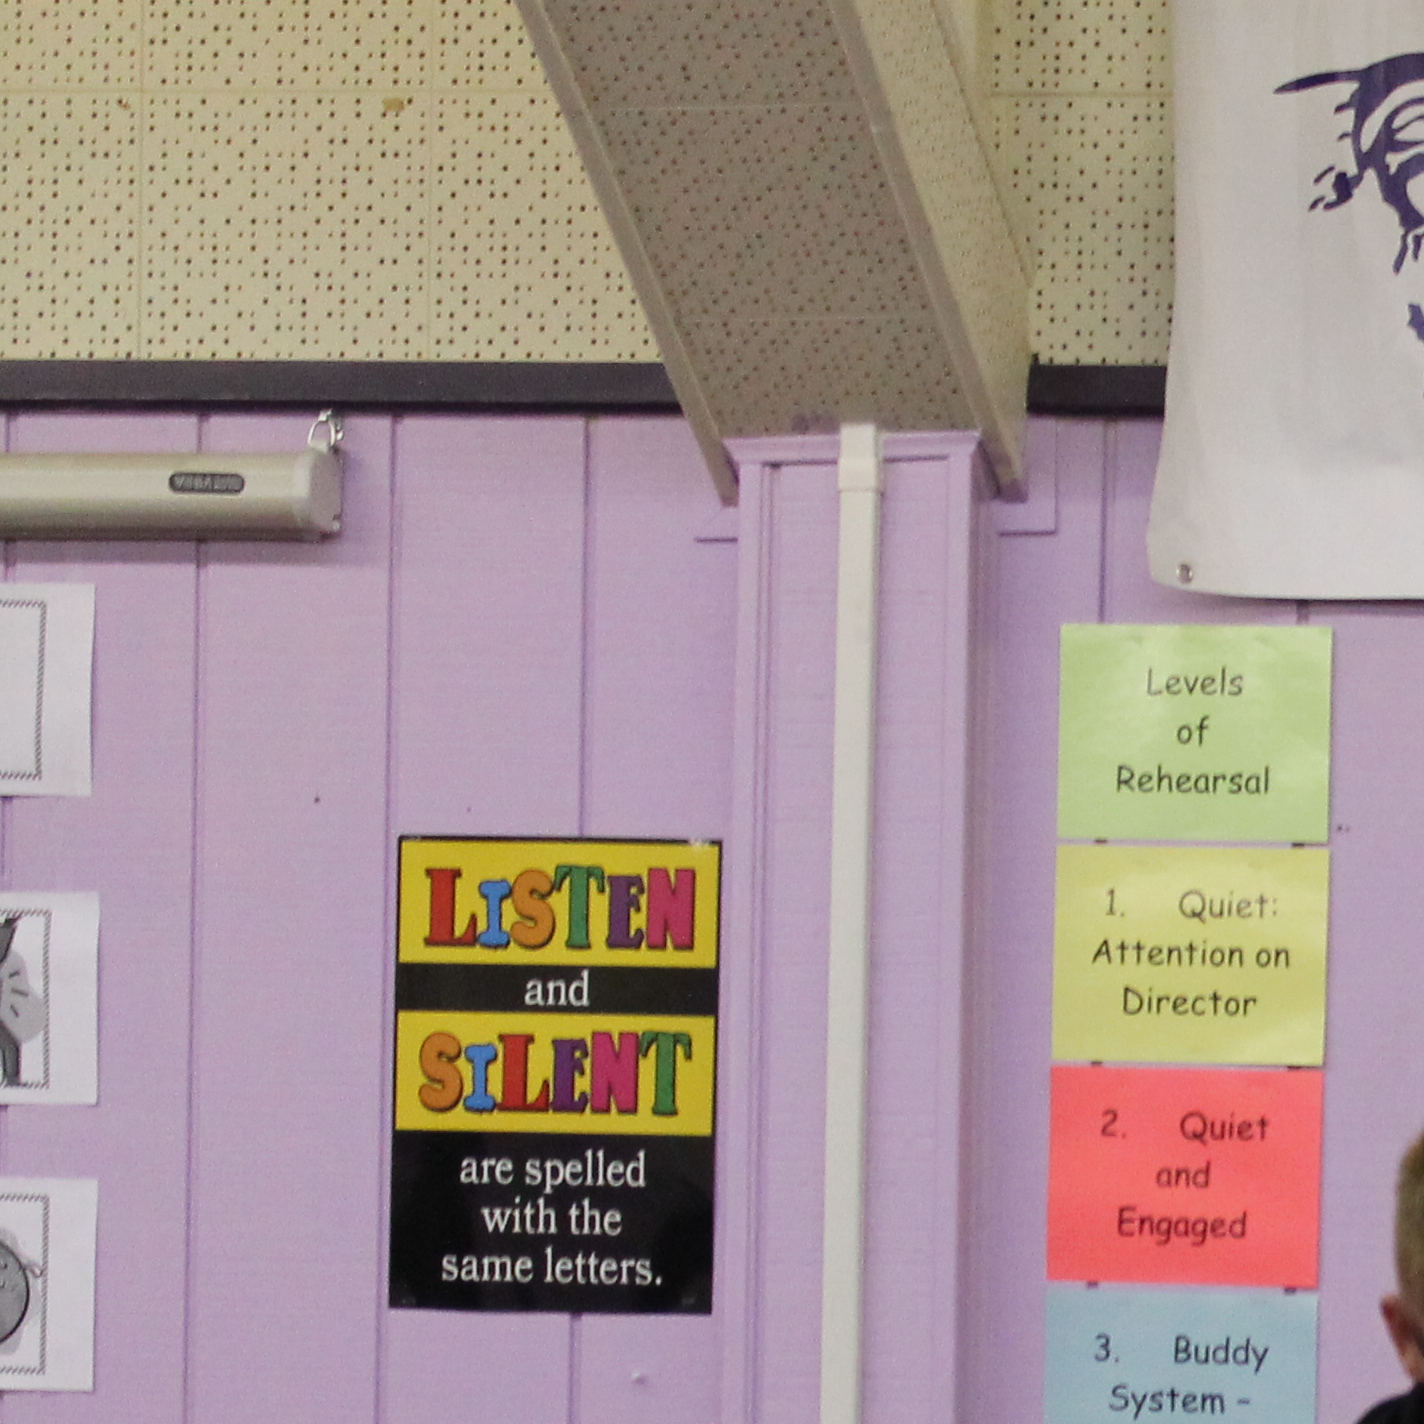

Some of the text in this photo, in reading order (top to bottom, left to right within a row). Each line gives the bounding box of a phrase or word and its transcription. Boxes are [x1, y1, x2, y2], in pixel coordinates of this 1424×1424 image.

[1146, 666, 1244, 696] Levels
[1176, 716, 1210, 746] of
[1116, 764, 1271, 796] Rehearsal
[423, 864, 697, 951] LISTEN
[1104, 888, 1279, 924] 1. Quiet:
[1091, 938, 1290, 969] Attention on
[524, 970, 591, 1008] and
[1122, 986, 1258, 1017] Director
[418, 1031, 693, 1117] SILENT
[1100, 1110, 1270, 1144] 2. Quiet
[459, 1149, 647, 1195] are spelled
[1156, 1161, 1212, 1190] and
[481, 1197, 623, 1236] with the
[1117, 1206, 1248, 1247] Engaged
[441, 1248, 664, 1287] same letters.
[1094, 1333, 1270, 1375] 3. Buddy
[1108, 1384, 1226, 1420] System
